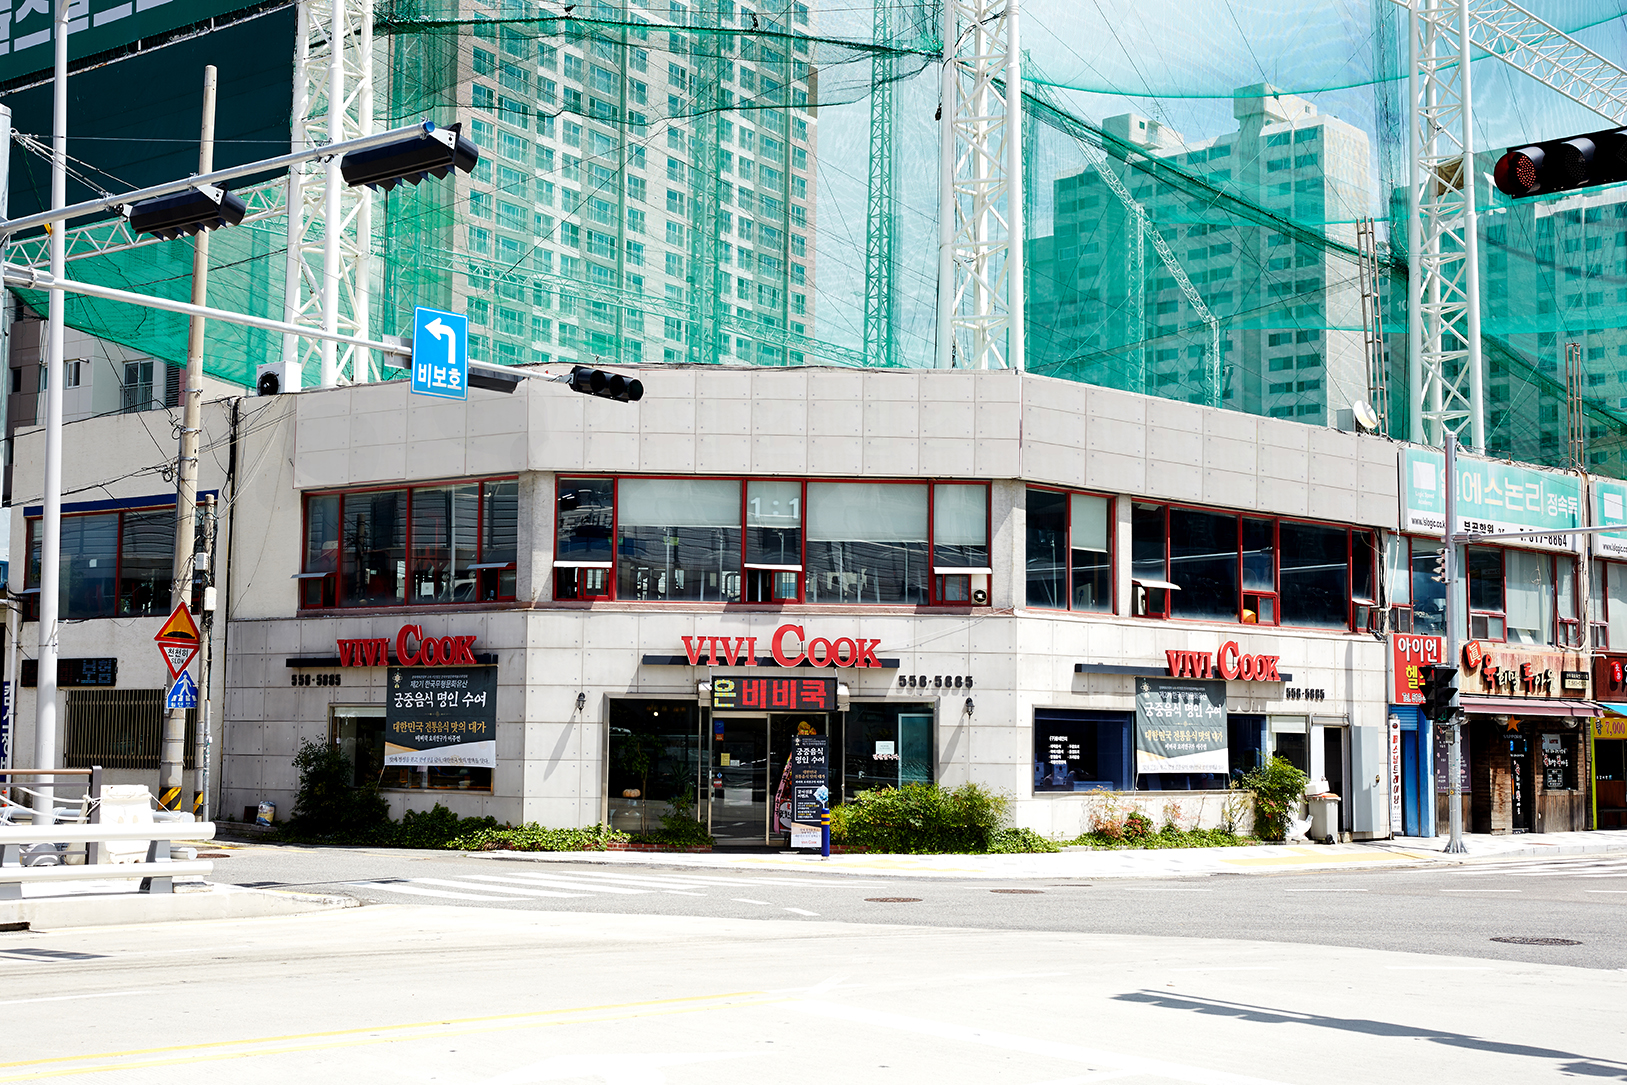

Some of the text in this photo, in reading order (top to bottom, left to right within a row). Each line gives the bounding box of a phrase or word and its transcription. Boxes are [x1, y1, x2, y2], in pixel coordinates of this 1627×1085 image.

[418, 363, 463, 391] 비보호
[750, 497, 799, 519] 1:1
[168, 648, 188, 657] 천천히
[337, 638, 390, 667] VIVI
[681, 635, 758, 667] VIVI
[1398, 637, 1437, 662] 아이언
[1165, 649, 1214, 679] VIVI
[394, 691, 487, 708] 궁중음식 명인 수여
[742, 679, 827, 709] 비비쿡
[1144, 701, 1222, 719] 궁중음식 명인 수여
[393, 721, 487, 734] 대한민국 전통음식 맛의 대가
[1144, 729, 1172, 742] 대한민국
[1173, 730, 1197, 742] 전통음식
[1198, 730, 1211, 742] 맛의
[1605, 721, 1625, 736] 7,000
[795, 755, 825, 764] 명인 수여
[796, 747, 824, 756] 궁중음식
